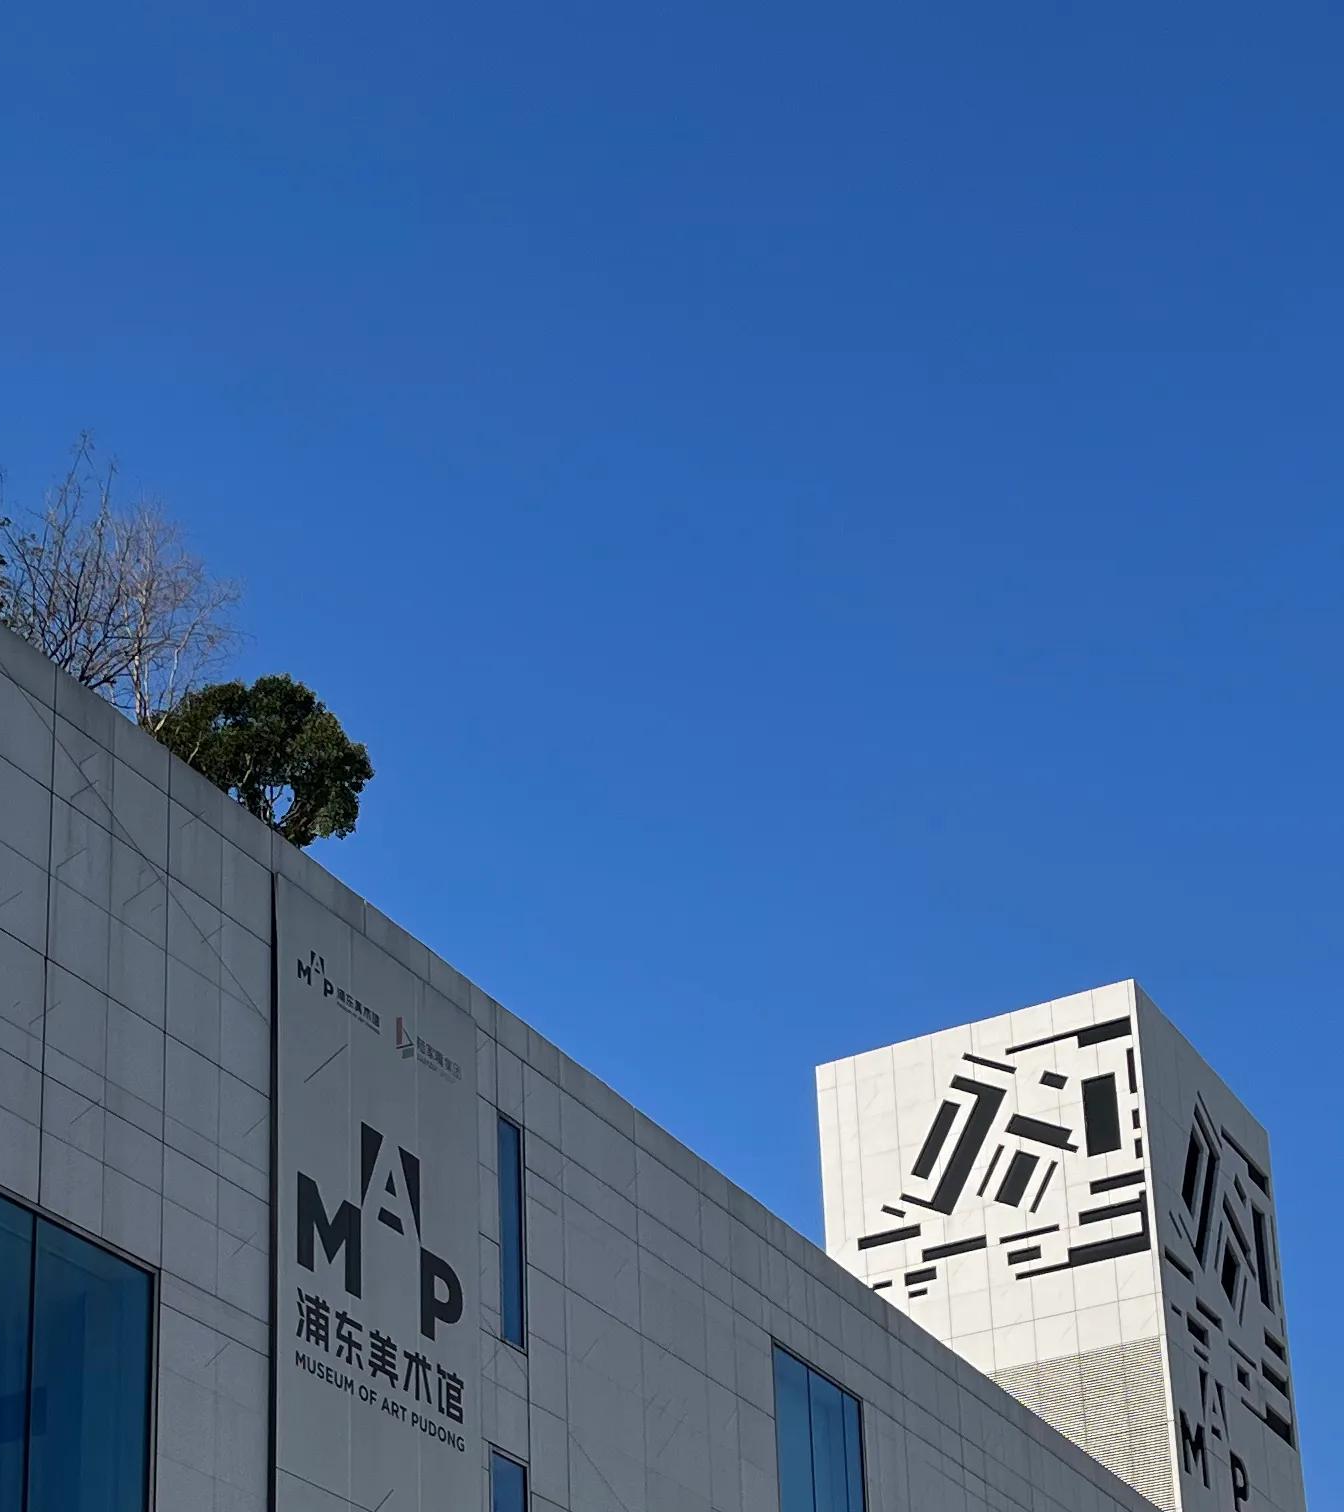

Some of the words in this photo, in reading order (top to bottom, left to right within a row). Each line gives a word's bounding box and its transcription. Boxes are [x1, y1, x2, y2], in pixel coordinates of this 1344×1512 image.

[297, 950, 334, 998] MAP
[297, 1121, 463, 1341] MAP
[295, 1350, 355, 1396] MUSEUM
[358, 1384, 378, 1406] OF
[381, 1396, 407, 1423] ART
[411, 1411, 465, 1453] PUDONG
[296, 1287, 464, 1425] 浦东美术馆
[1178, 1367, 1249, 1512] MAP
